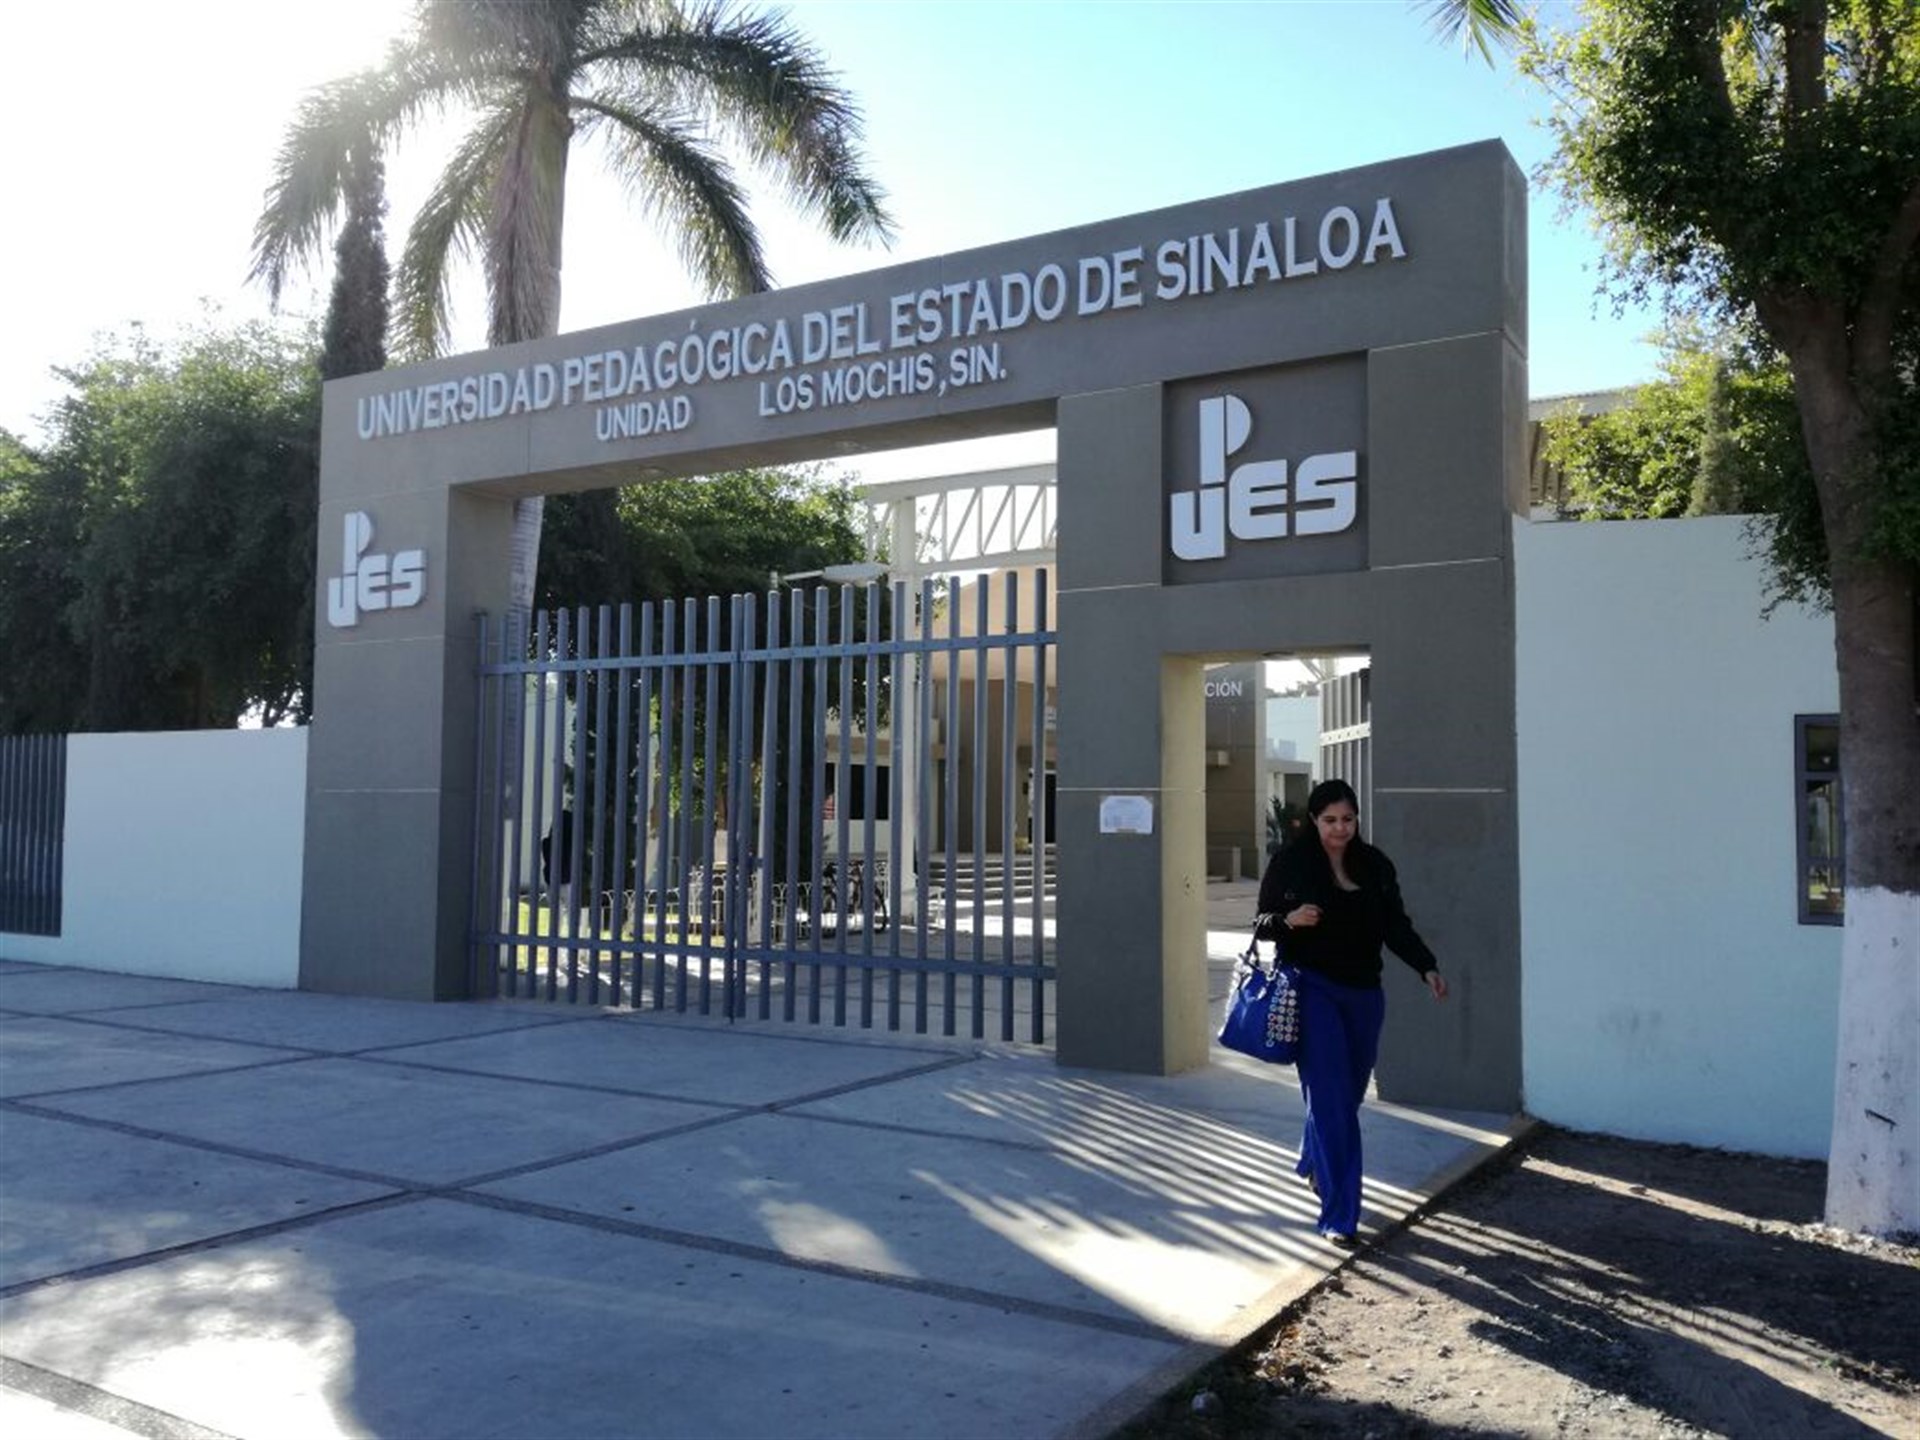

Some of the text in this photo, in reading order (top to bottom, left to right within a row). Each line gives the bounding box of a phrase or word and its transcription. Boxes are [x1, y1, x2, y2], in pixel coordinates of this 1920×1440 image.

[357, 198, 1406, 439] UNIVERSIDAD PEDAGÓGICA DEL ESTADO DE SINALOA
[596, 395, 691, 440] UNIDAD
[759, 374, 814, 416] LOS
